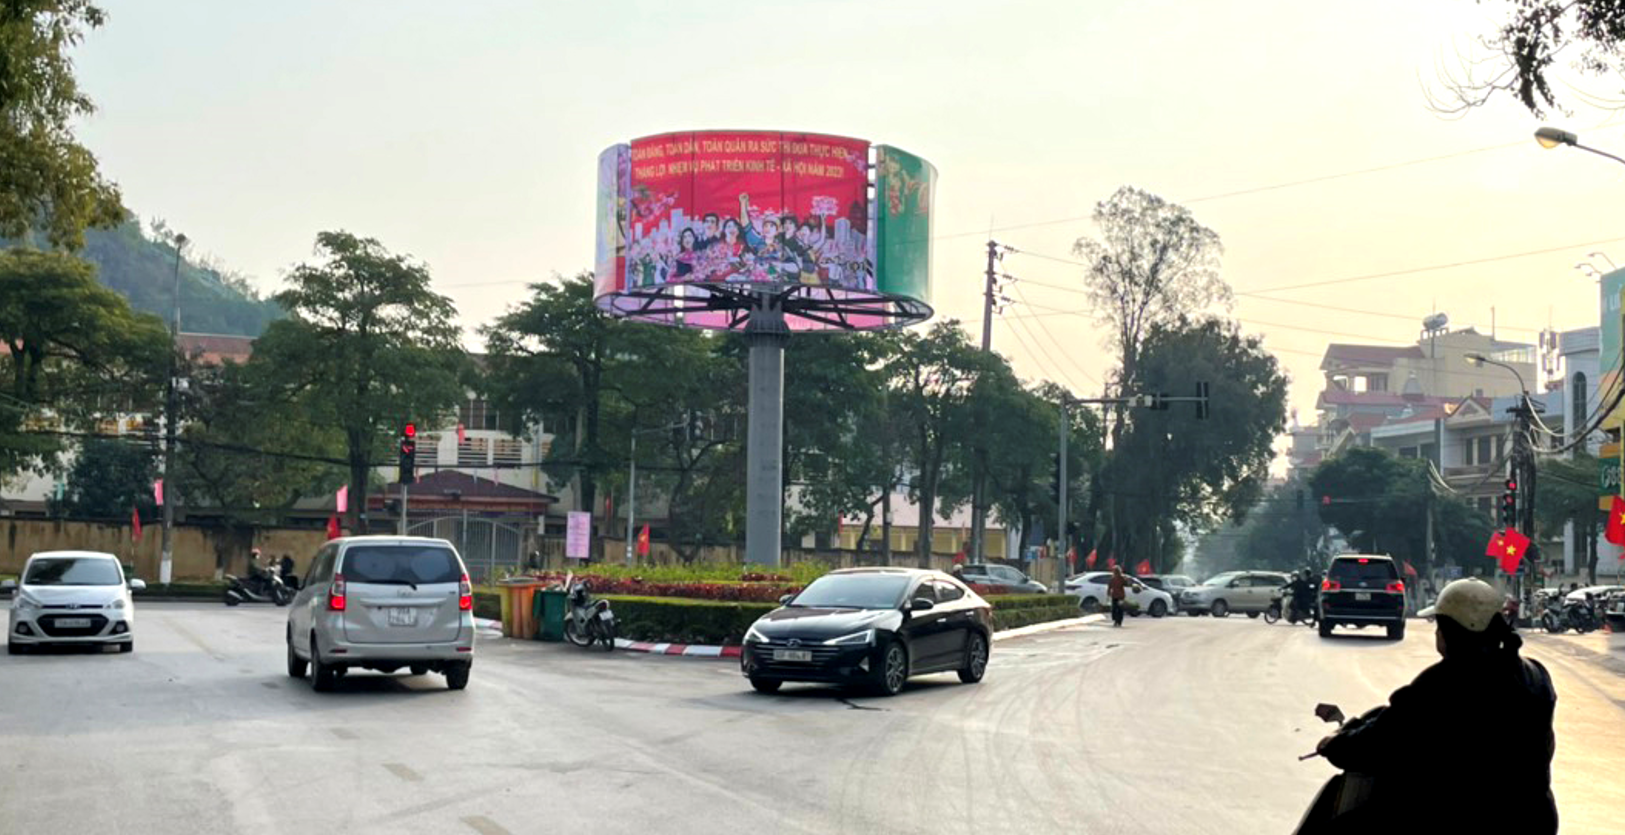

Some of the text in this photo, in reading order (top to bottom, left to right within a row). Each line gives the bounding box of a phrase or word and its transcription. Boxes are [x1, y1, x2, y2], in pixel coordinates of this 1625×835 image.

[702, 138, 722, 153] TOÀN
[724, 137, 746, 153] QUÂN
[748, 140, 759, 153] RA
